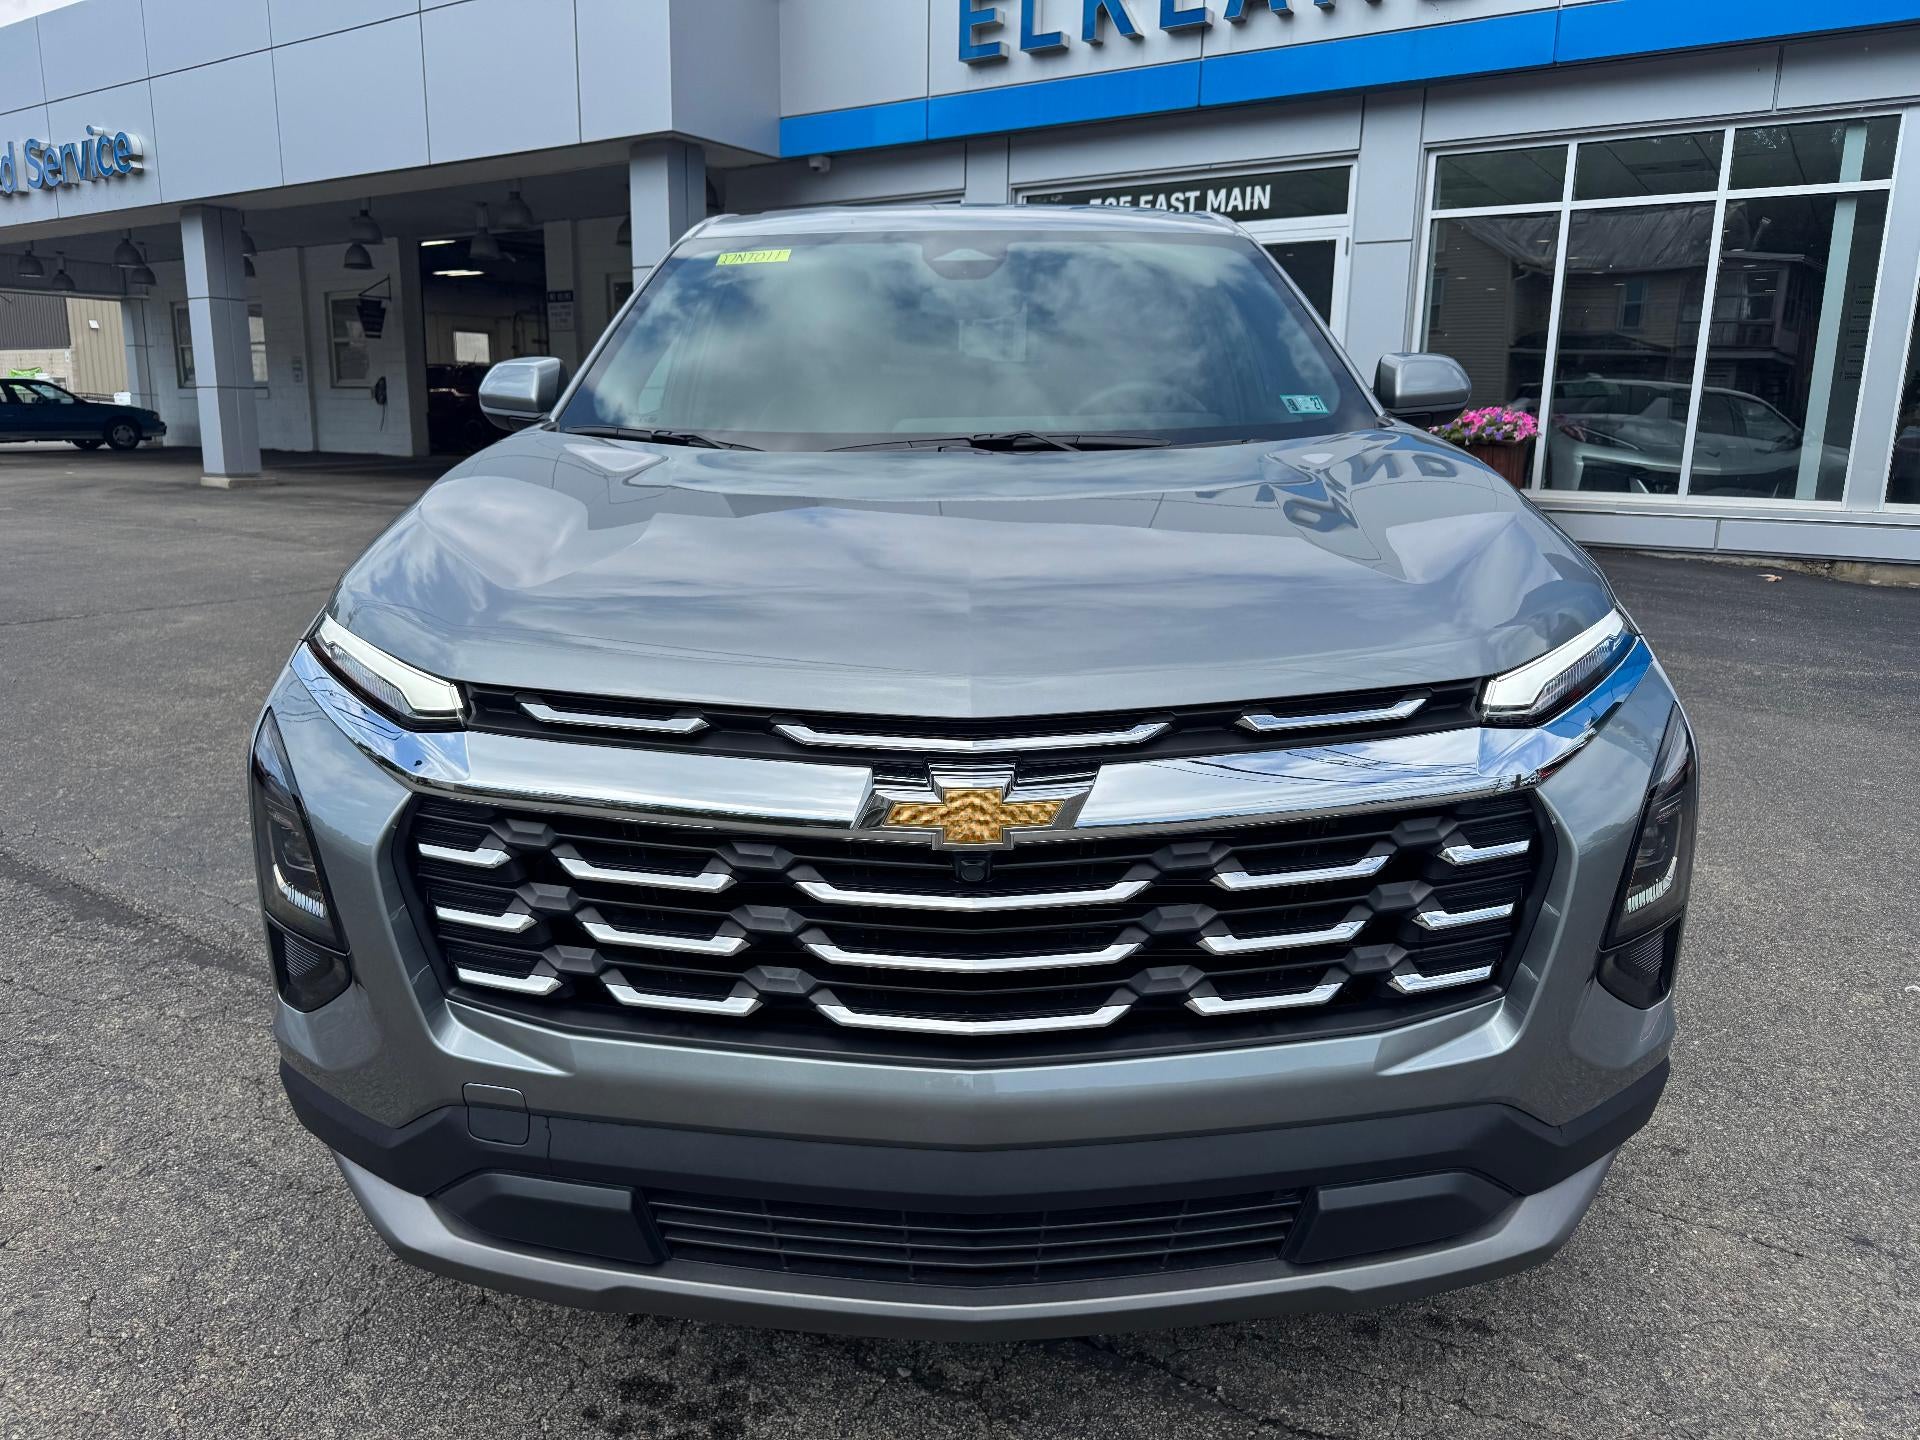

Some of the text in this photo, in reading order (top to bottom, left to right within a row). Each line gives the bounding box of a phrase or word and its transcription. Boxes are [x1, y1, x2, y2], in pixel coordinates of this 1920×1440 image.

[25, 125, 140, 189] Service
[1139, 184, 1271, 213] EAST MAIN
